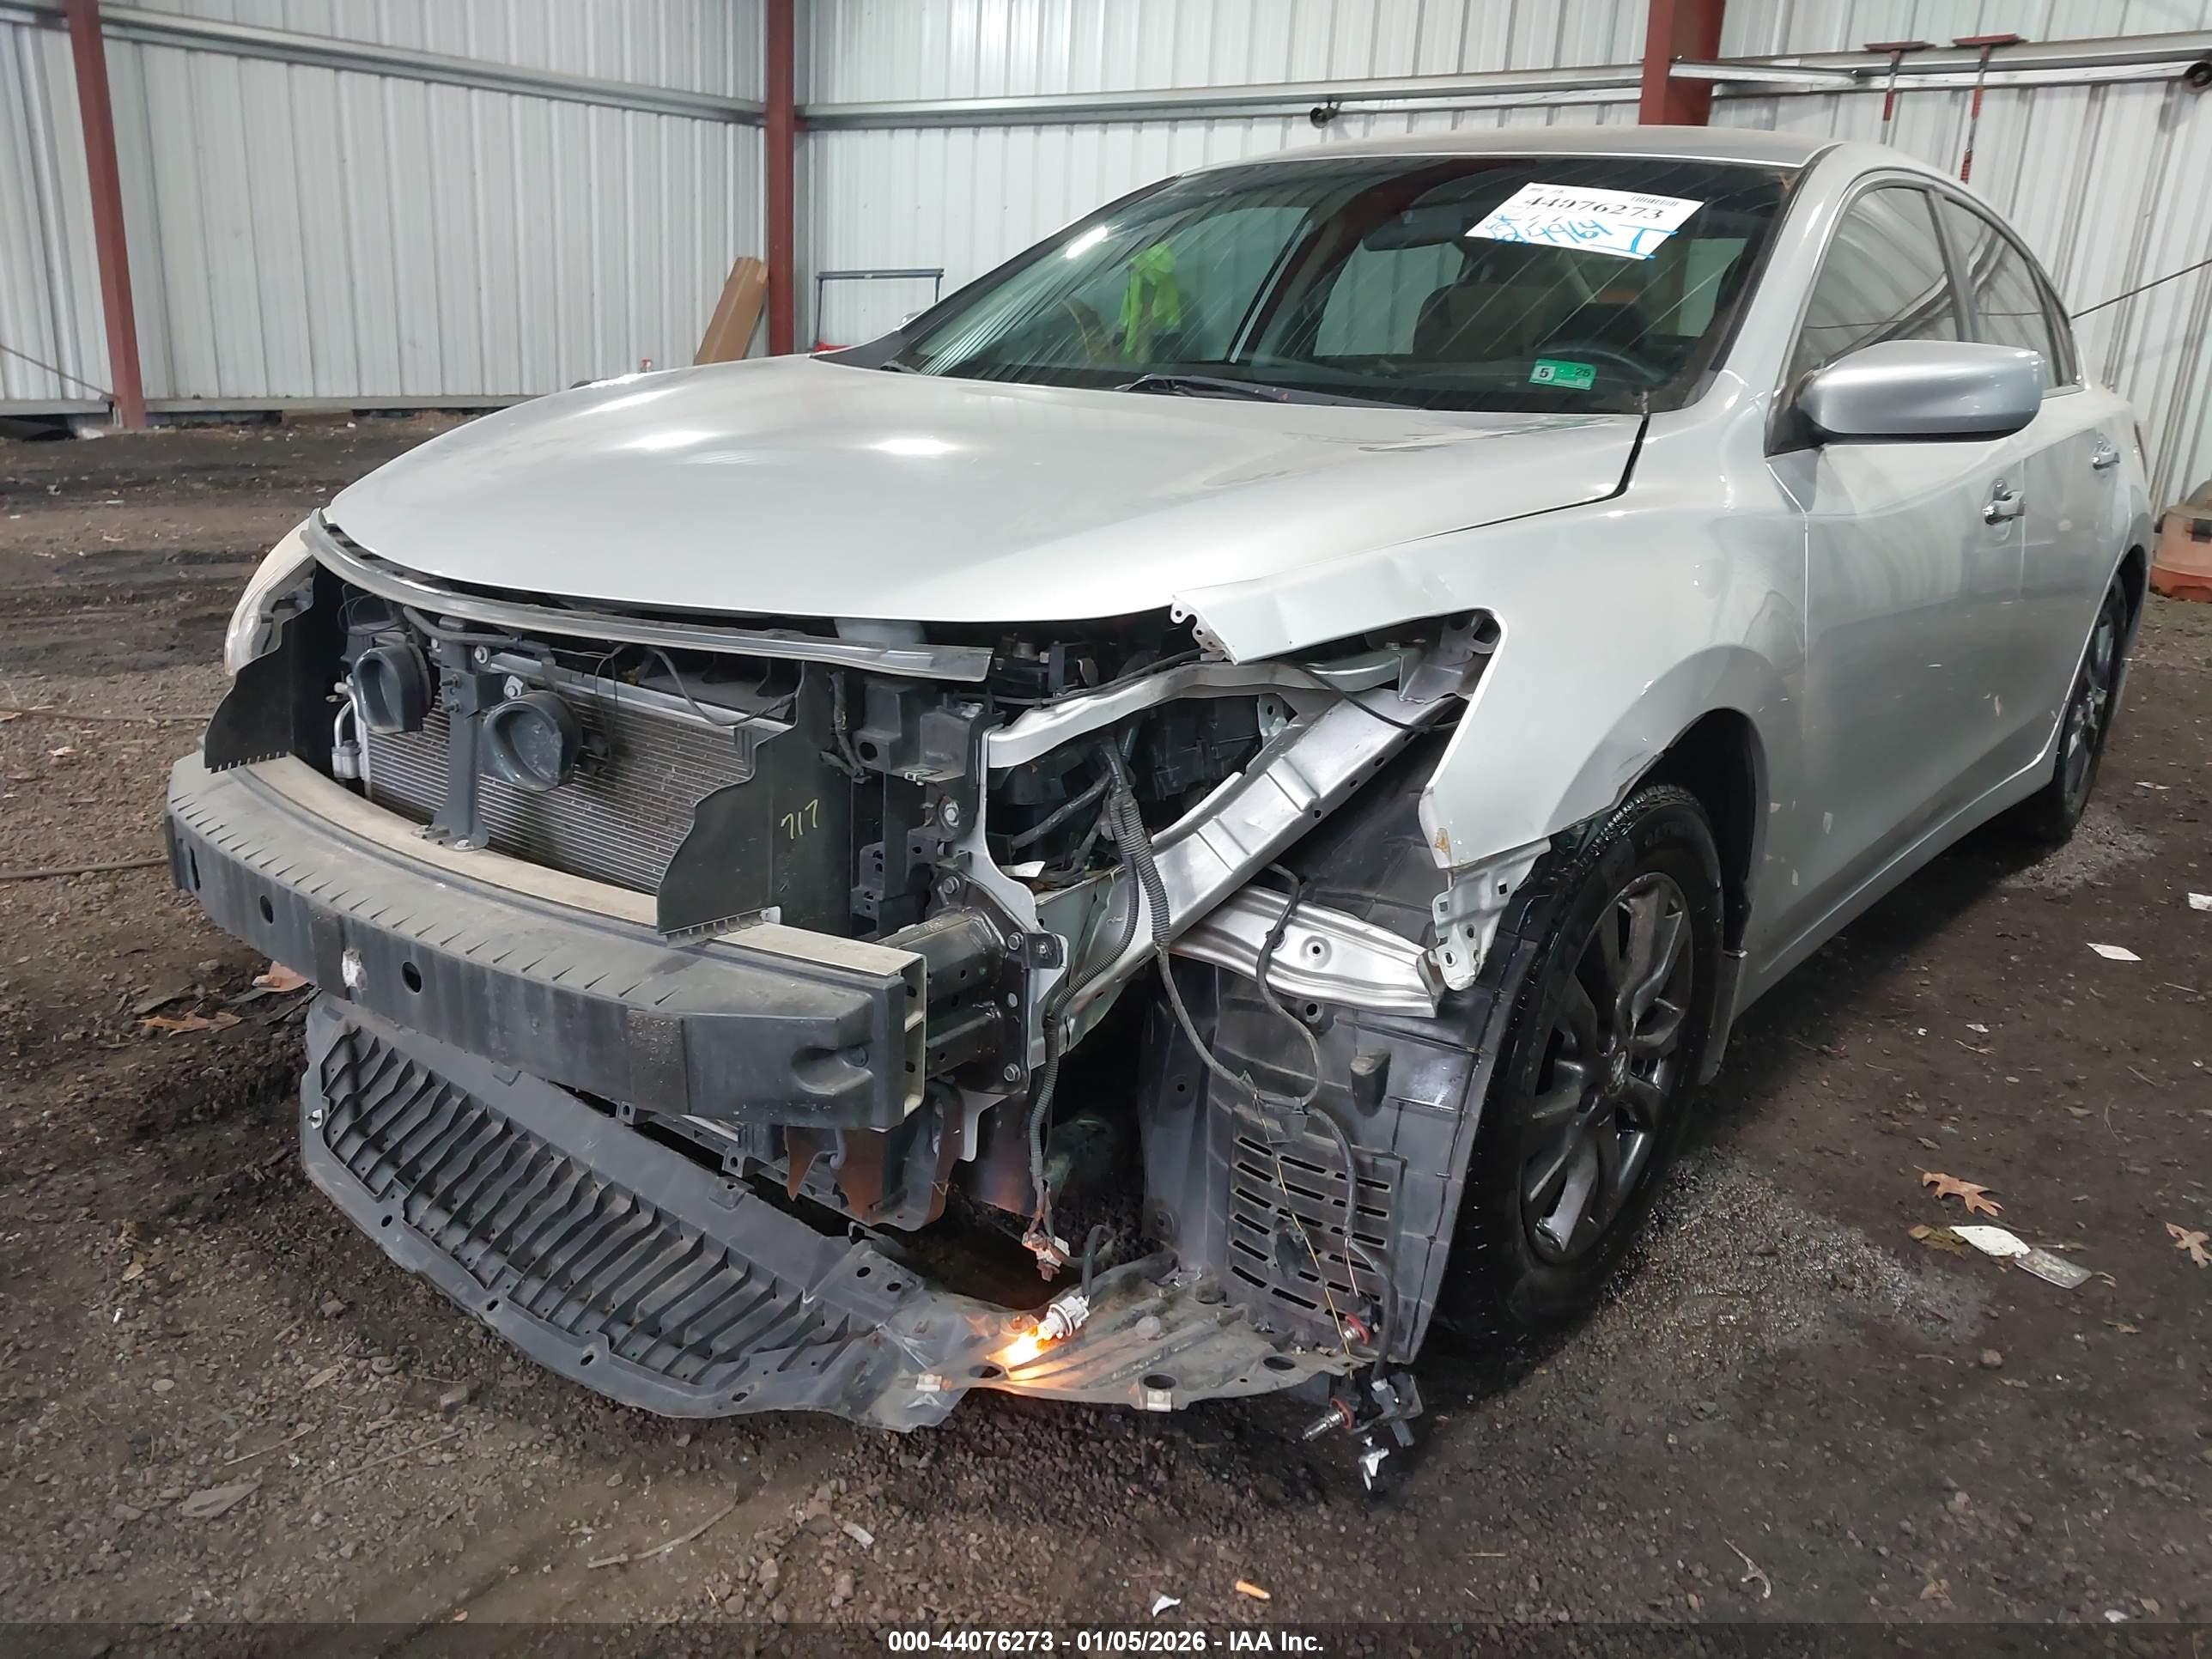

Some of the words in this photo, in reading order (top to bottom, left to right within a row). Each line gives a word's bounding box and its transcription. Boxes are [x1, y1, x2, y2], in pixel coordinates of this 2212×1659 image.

[1524, 196, 1664, 220] 44076273
[1539, 367, 1550, 379] 5
[780, 799, 818, 840] 717
